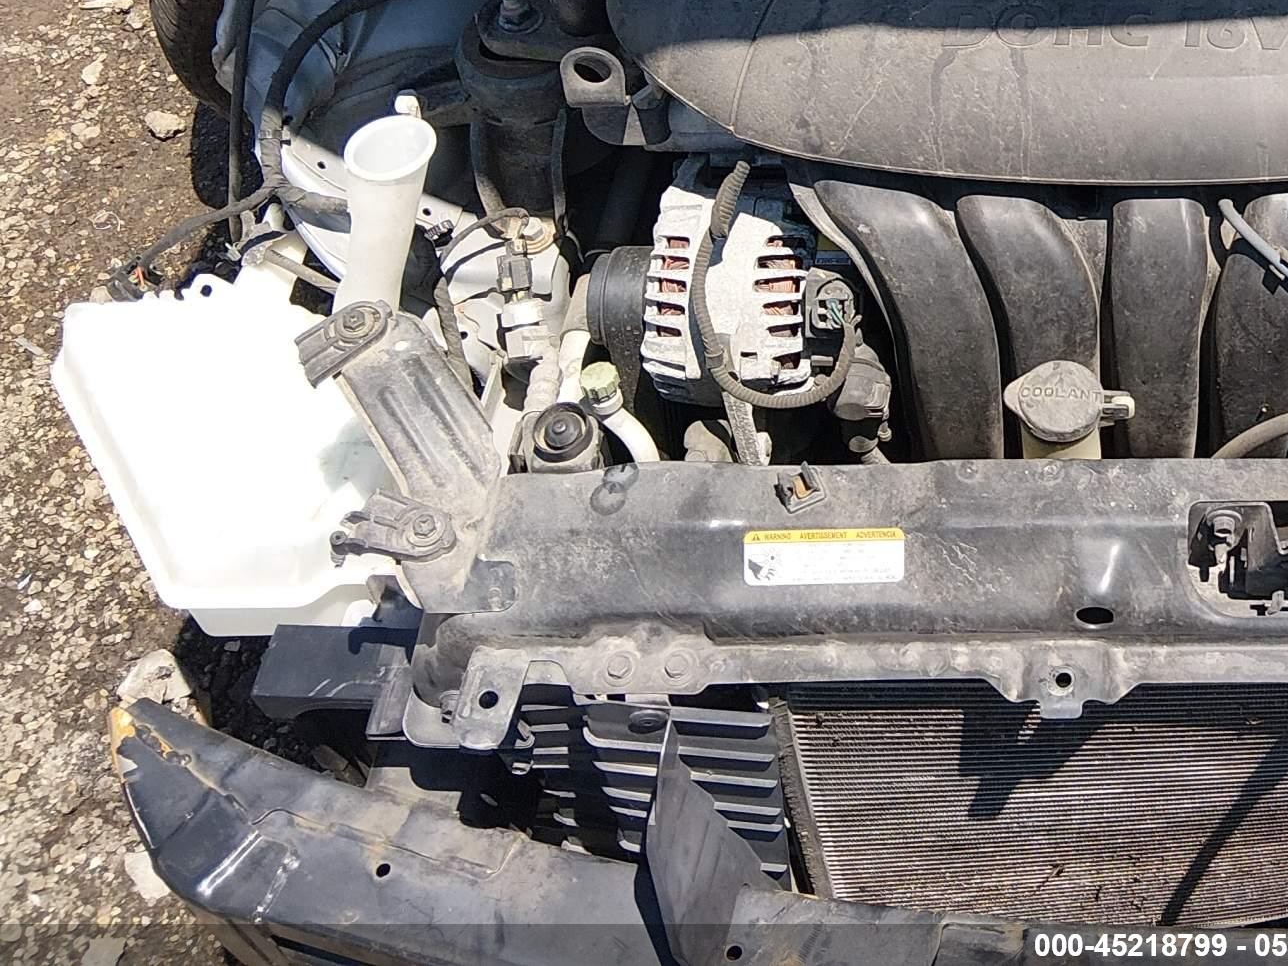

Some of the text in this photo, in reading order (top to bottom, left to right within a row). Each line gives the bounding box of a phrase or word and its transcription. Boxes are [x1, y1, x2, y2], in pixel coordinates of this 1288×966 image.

[940, 4, 1153, 49] DOHC
[1020, 386, 1102, 403] COOLANT
[764, 532, 792, 541] WARNING
